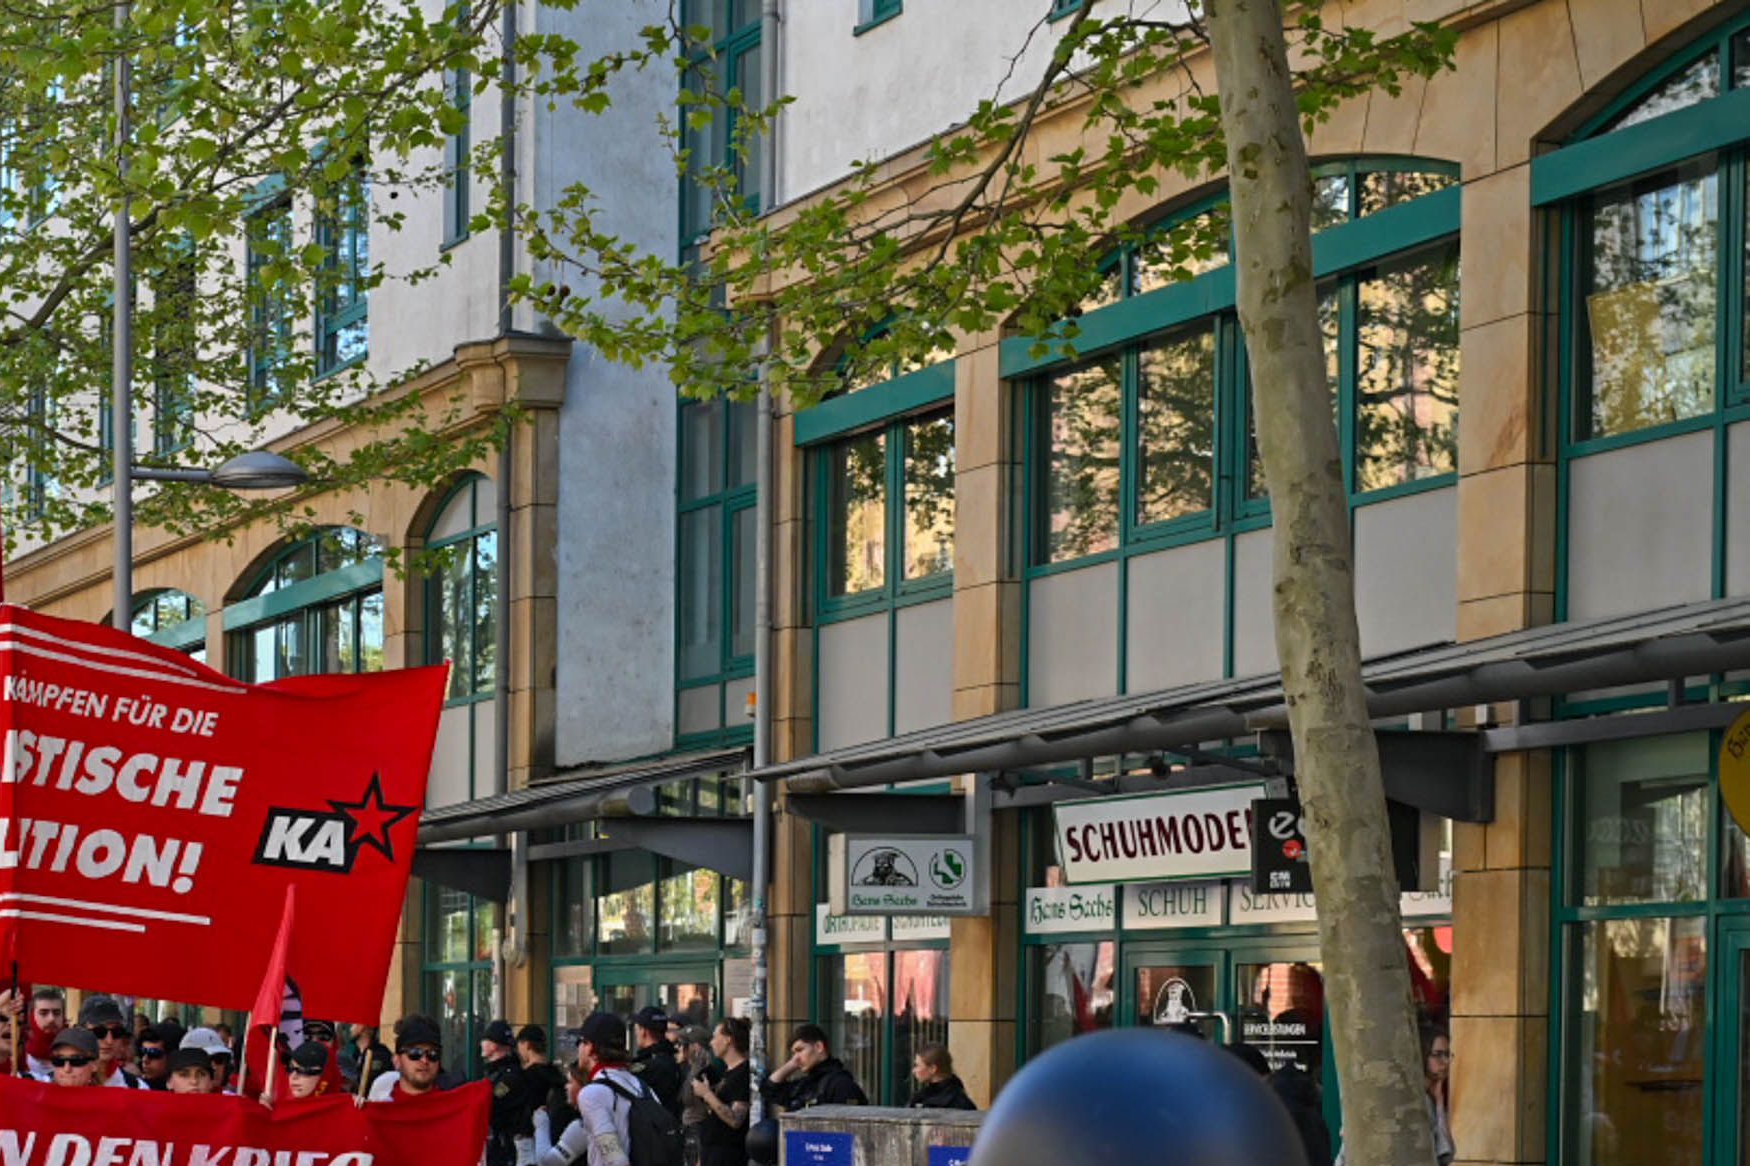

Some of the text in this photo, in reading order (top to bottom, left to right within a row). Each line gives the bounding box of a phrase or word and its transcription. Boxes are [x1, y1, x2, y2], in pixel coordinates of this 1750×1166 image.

[4, 669, 108, 719] KÄMPFEN
[112, 695, 169, 730] FÜR
[171, 706, 218, 737] DIE
[263, 816, 346, 868] KA
[1138, 886, 1207, 917] SCHUH
